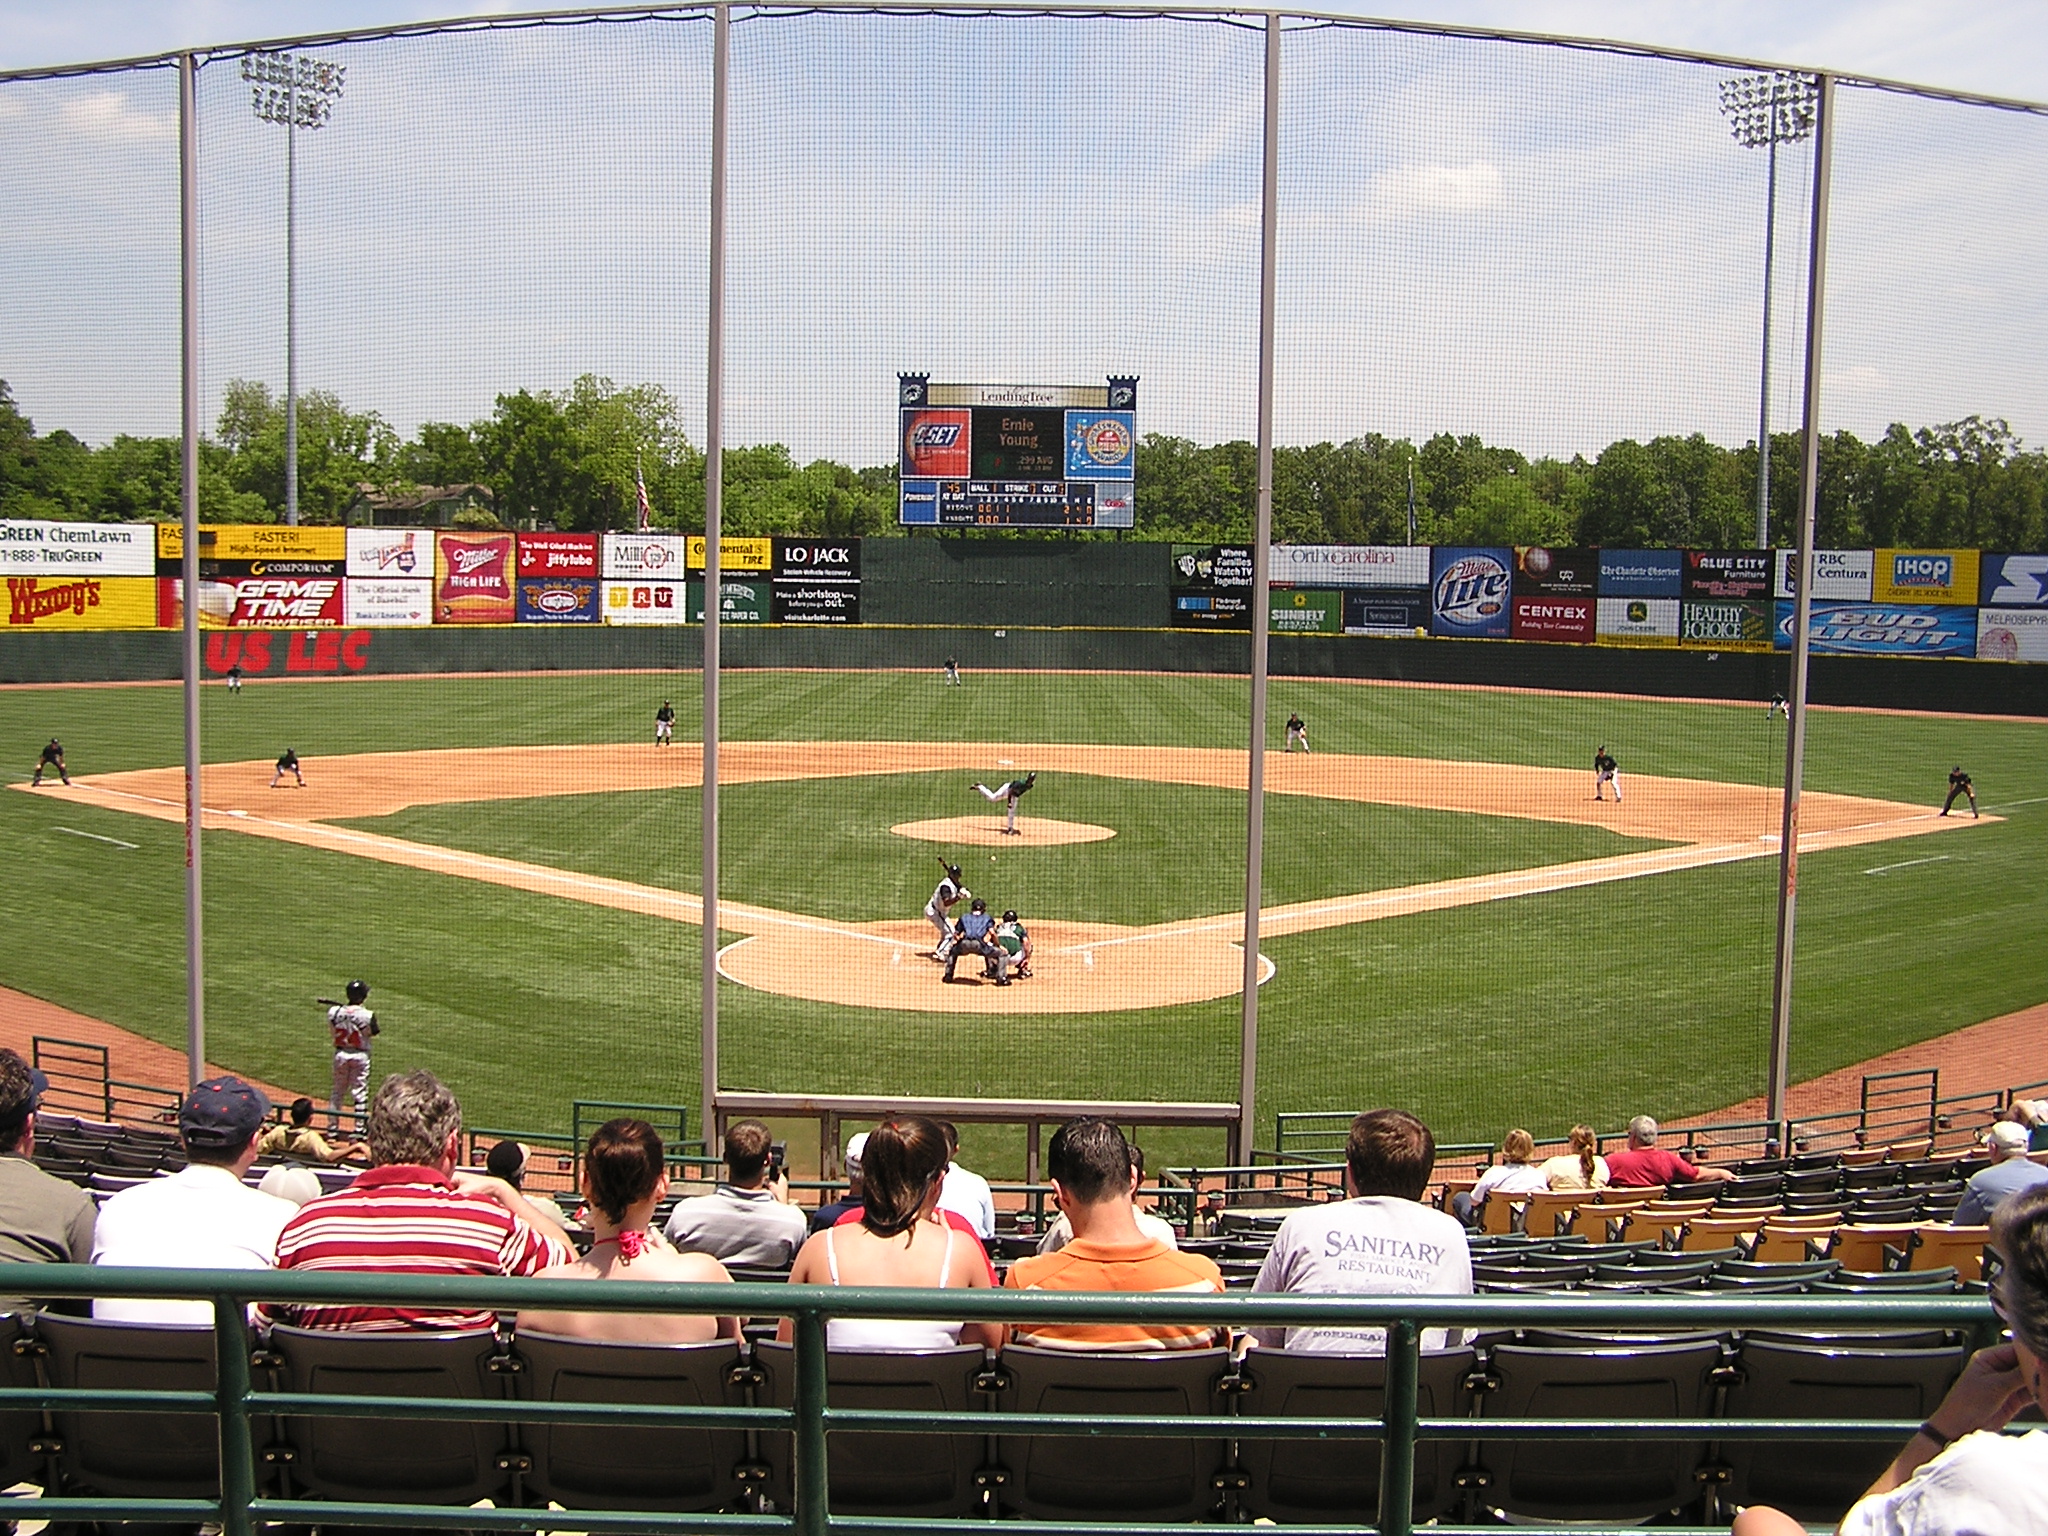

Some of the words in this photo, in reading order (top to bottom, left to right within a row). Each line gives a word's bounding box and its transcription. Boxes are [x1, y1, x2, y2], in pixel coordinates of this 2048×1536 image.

[981, 391, 1054, 405] LendingTree
[1002, 418, 1034, 431] Ernie
[1000, 434, 1039, 449] Young
[970, 484, 989, 493] BALL
[1004, 484, 1029, 493] STRIKE
[1042, 484, 1057, 493] OUT
[50, 527, 132, 543] ChemLawn
[253, 531, 299, 543] FASTER!
[453, 548, 499, 570] Miller
[546, 553, 569, 567] jiffy
[569, 554, 593, 565] lube
[743, 555, 763, 565] TIRE
[1220, 549, 1247, 558] Where
[1819, 554, 1846, 565] RBC
[1216, 557, 1252, 566] Families
[1690, 552, 1733, 569] VALUE
[267, 563, 334, 573] COMPORIUM
[1214, 567, 1241, 576] Watch
[1241, 567, 1253, 576] TV
[1455, 562, 1496, 579] Miller
[1601, 565, 1615, 577] The
[1616, 566, 1647, 577] Charlotte
[1648, 566, 1680, 577] Observer
[1723, 570, 1766, 578] Furniture
[1817, 567, 1867, 578] Centura
[1896, 560, 1948, 580] IHOP
[450, 575, 477, 587] HIGH
[479, 575, 501, 587] LIFE
[1213, 576, 1253, 587] Together!
[236, 580, 338, 598] GAME
[797, 588, 840, 600] shortstop
[1440, 574, 1507, 611] Lite
[8, 578, 101, 624] Wendy's
[243, 599, 326, 617] TIME
[1519, 605, 1586, 619] CENTEX
[1683, 604, 1743, 622] HEALTHY
[1271, 609, 1326, 621] SUNBELT
[1828, 611, 1940, 629] BUD
[1555, 622, 1584, 631] Community
[1617, 625, 1634, 633] JOHN
[1635, 625, 1657, 633] DEERE
[1690, 622, 1742, 639] CHOICE
[1809, 626, 1958, 645] LIGHT
[205, 631, 273, 674] US
[285, 629, 373, 672] LEC
[1324, 1230, 1446, 1267] SANITARY
[1337, 1260, 1432, 1285] RESTAURANT
